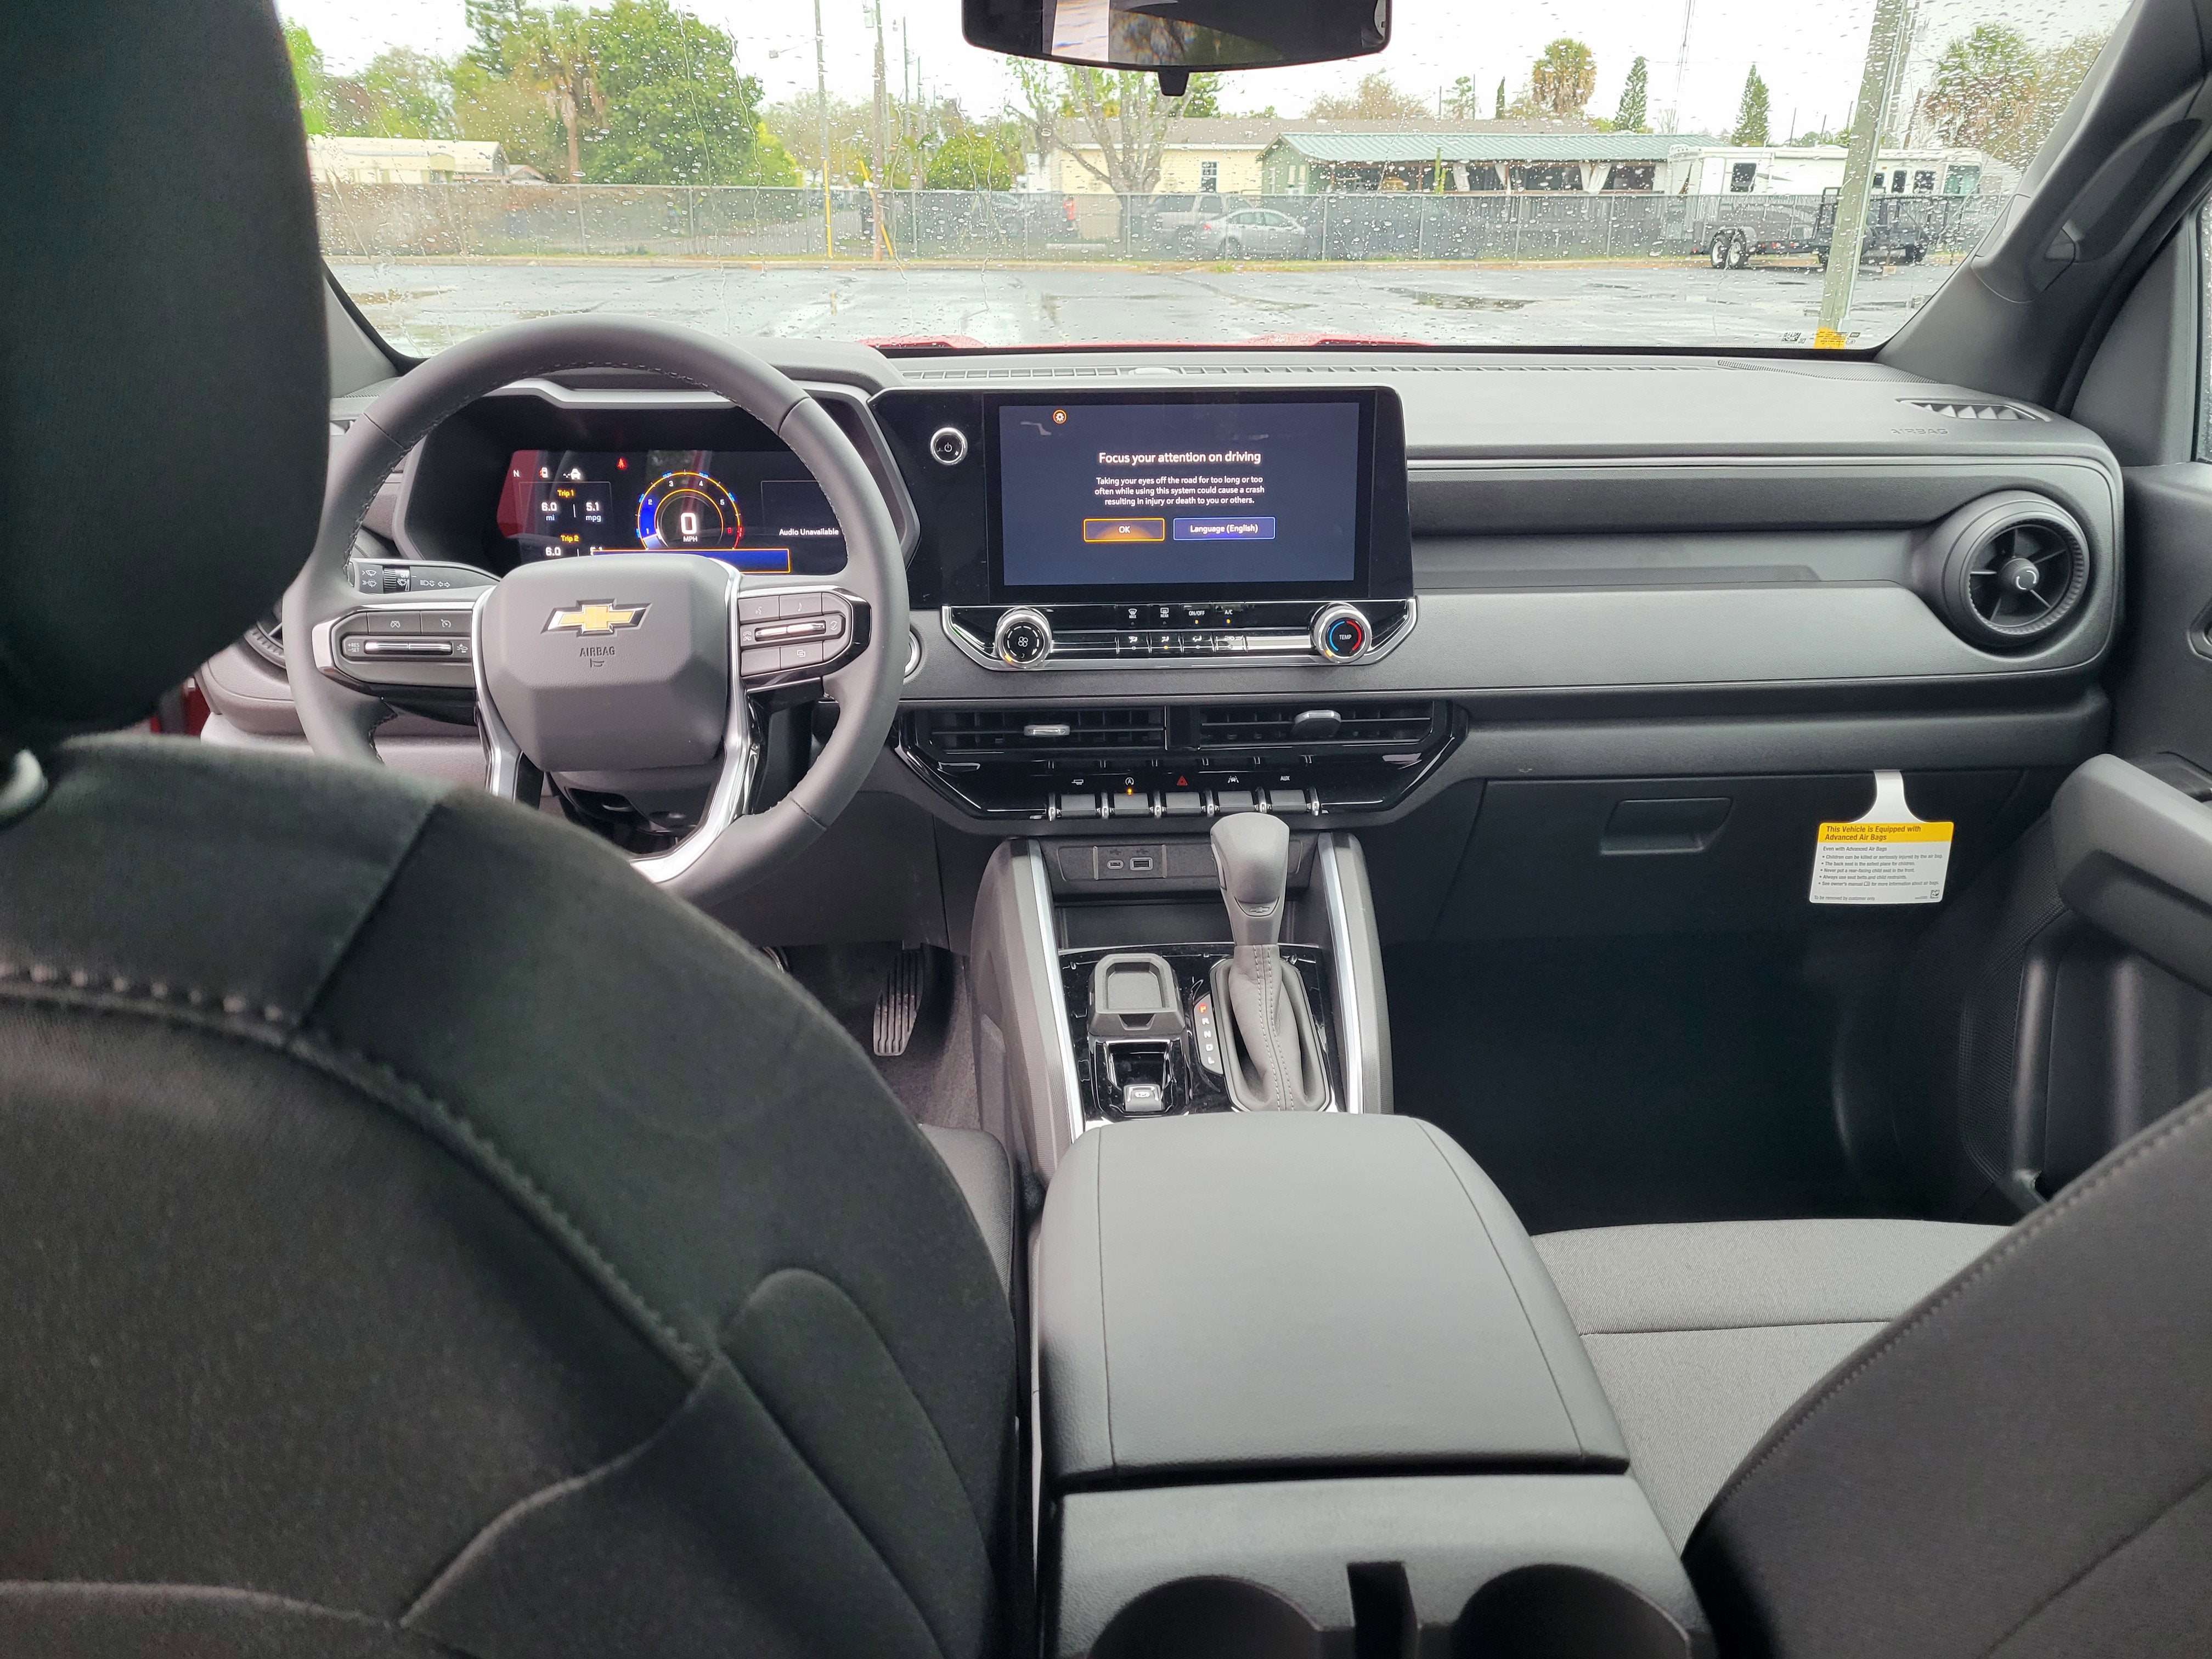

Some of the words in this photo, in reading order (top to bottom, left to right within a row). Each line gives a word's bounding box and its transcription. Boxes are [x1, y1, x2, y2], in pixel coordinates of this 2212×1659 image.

[1099, 452, 1130, 464] Focus
[1132, 454, 1156, 466] your
[1158, 452, 1206, 463] attention
[1209, 453, 1222, 462] on
[1225, 451, 1261, 464] driving
[1096, 477, 1119, 486] Taking
[1121, 478, 1137, 487] your
[1156, 476, 1167, 484] off
[1199, 476, 1209, 484] for
[1224, 476, 1240, 485] long
[557, 489, 570, 498] Trip
[1136, 487, 1154, 496] using
[1171, 487, 1195, 496] system
[1105, 497, 1136, 506] resulting
[1145, 497, 1165, 506] injury
[541, 502, 557, 511] 6.0
[586, 502, 599, 511] 5.1
[680, 512, 697, 534] 0
[1119, 526, 1131, 534] OK
[1190, 524, 1225, 534] Language
[1226, 524, 1258, 534] (English)
[545, 547, 561, 556] 6.0
[580, 646, 615, 657] AIRBAG
